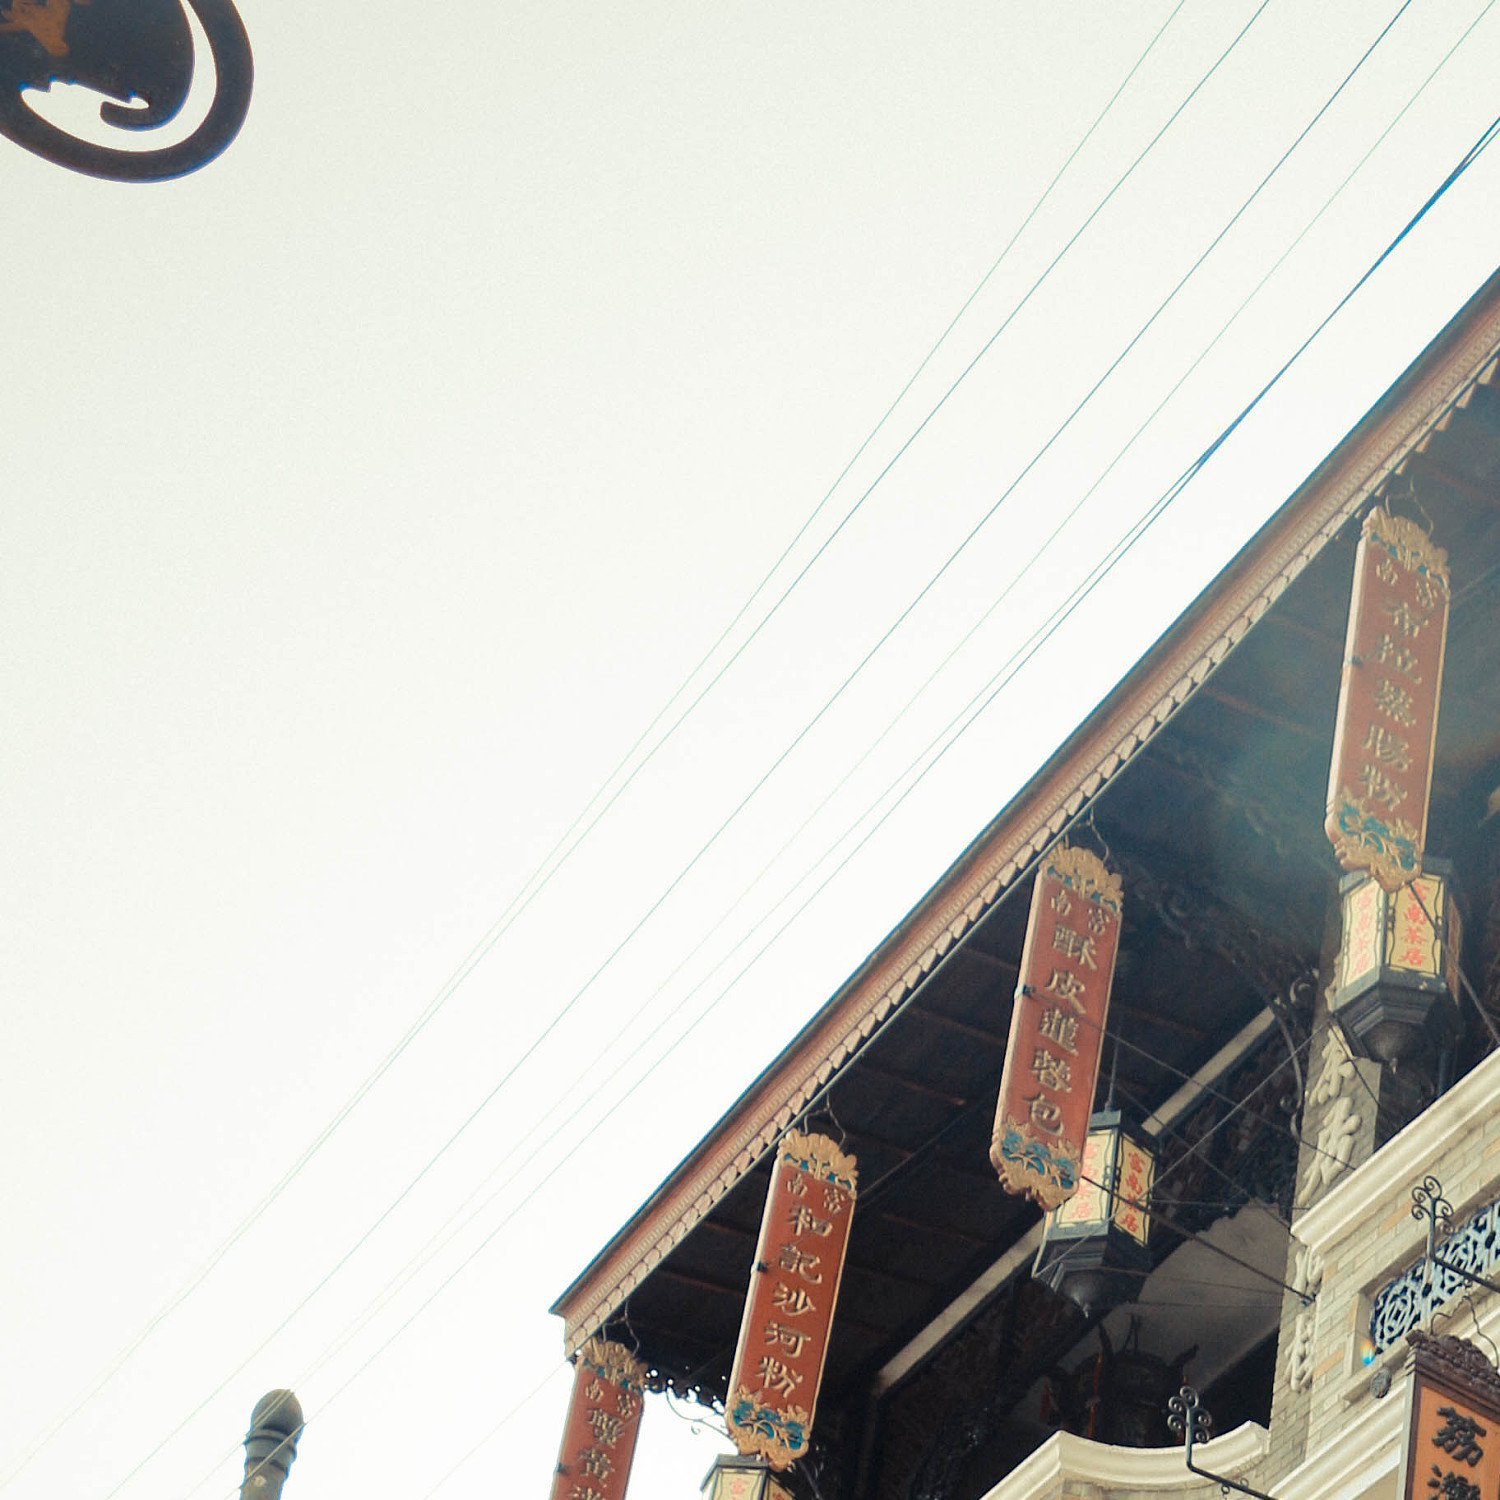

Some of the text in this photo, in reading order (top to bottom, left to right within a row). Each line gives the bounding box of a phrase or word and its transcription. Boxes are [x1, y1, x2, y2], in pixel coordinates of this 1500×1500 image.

[754, 1205, 833, 1400] 和記沙河粉
